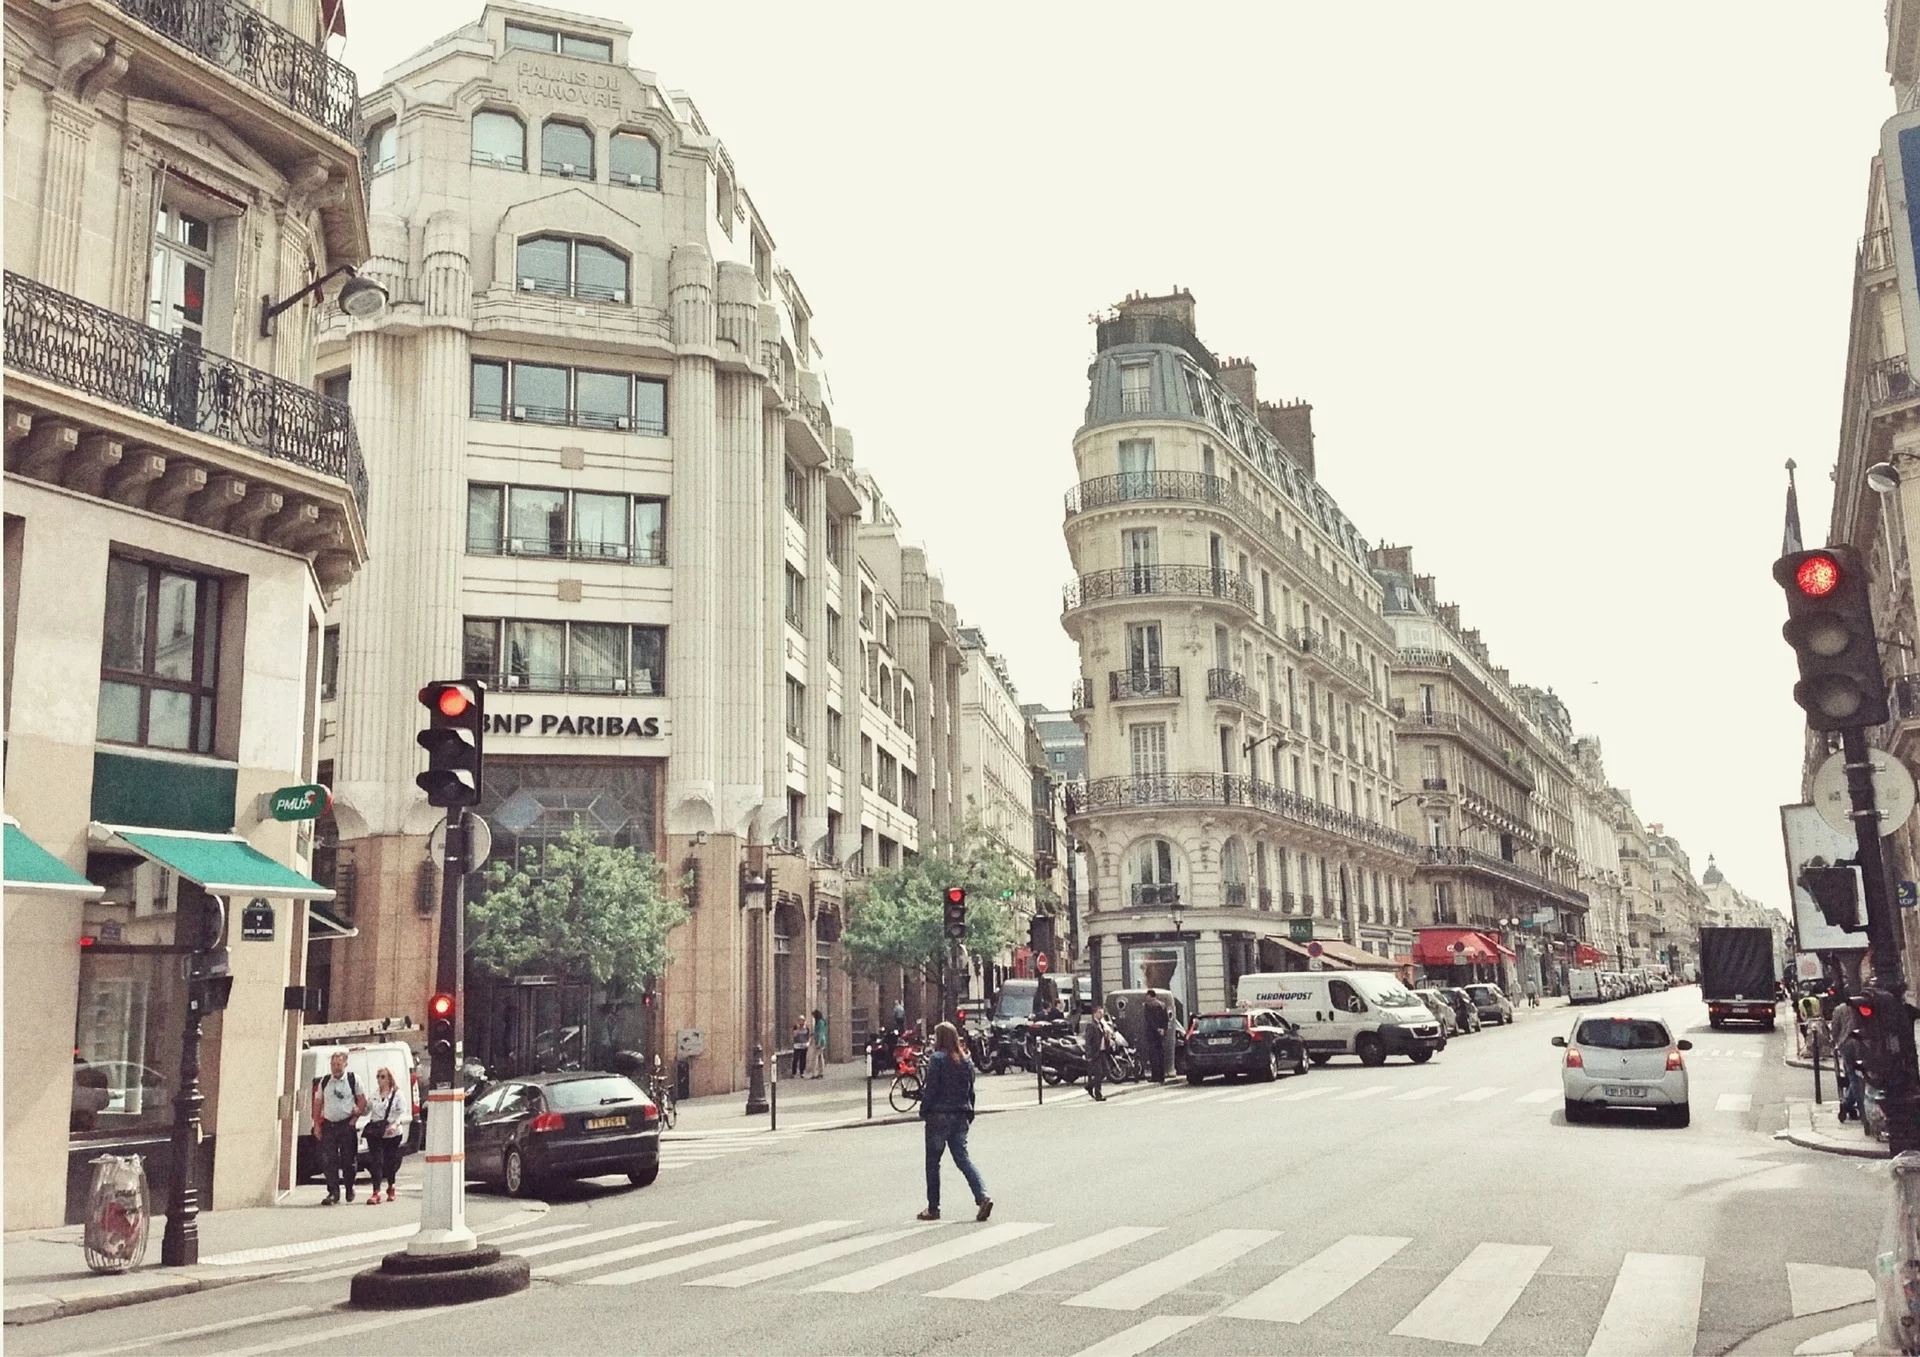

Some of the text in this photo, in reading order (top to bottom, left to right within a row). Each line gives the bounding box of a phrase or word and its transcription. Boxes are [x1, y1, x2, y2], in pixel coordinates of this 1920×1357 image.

[517, 60, 620, 92] PALAIS DU
[517, 79, 622, 109] HANOVRE
[541, 714, 659, 737] PARIBAS
[1256, 992, 1313, 1000] CHRONOPOST
